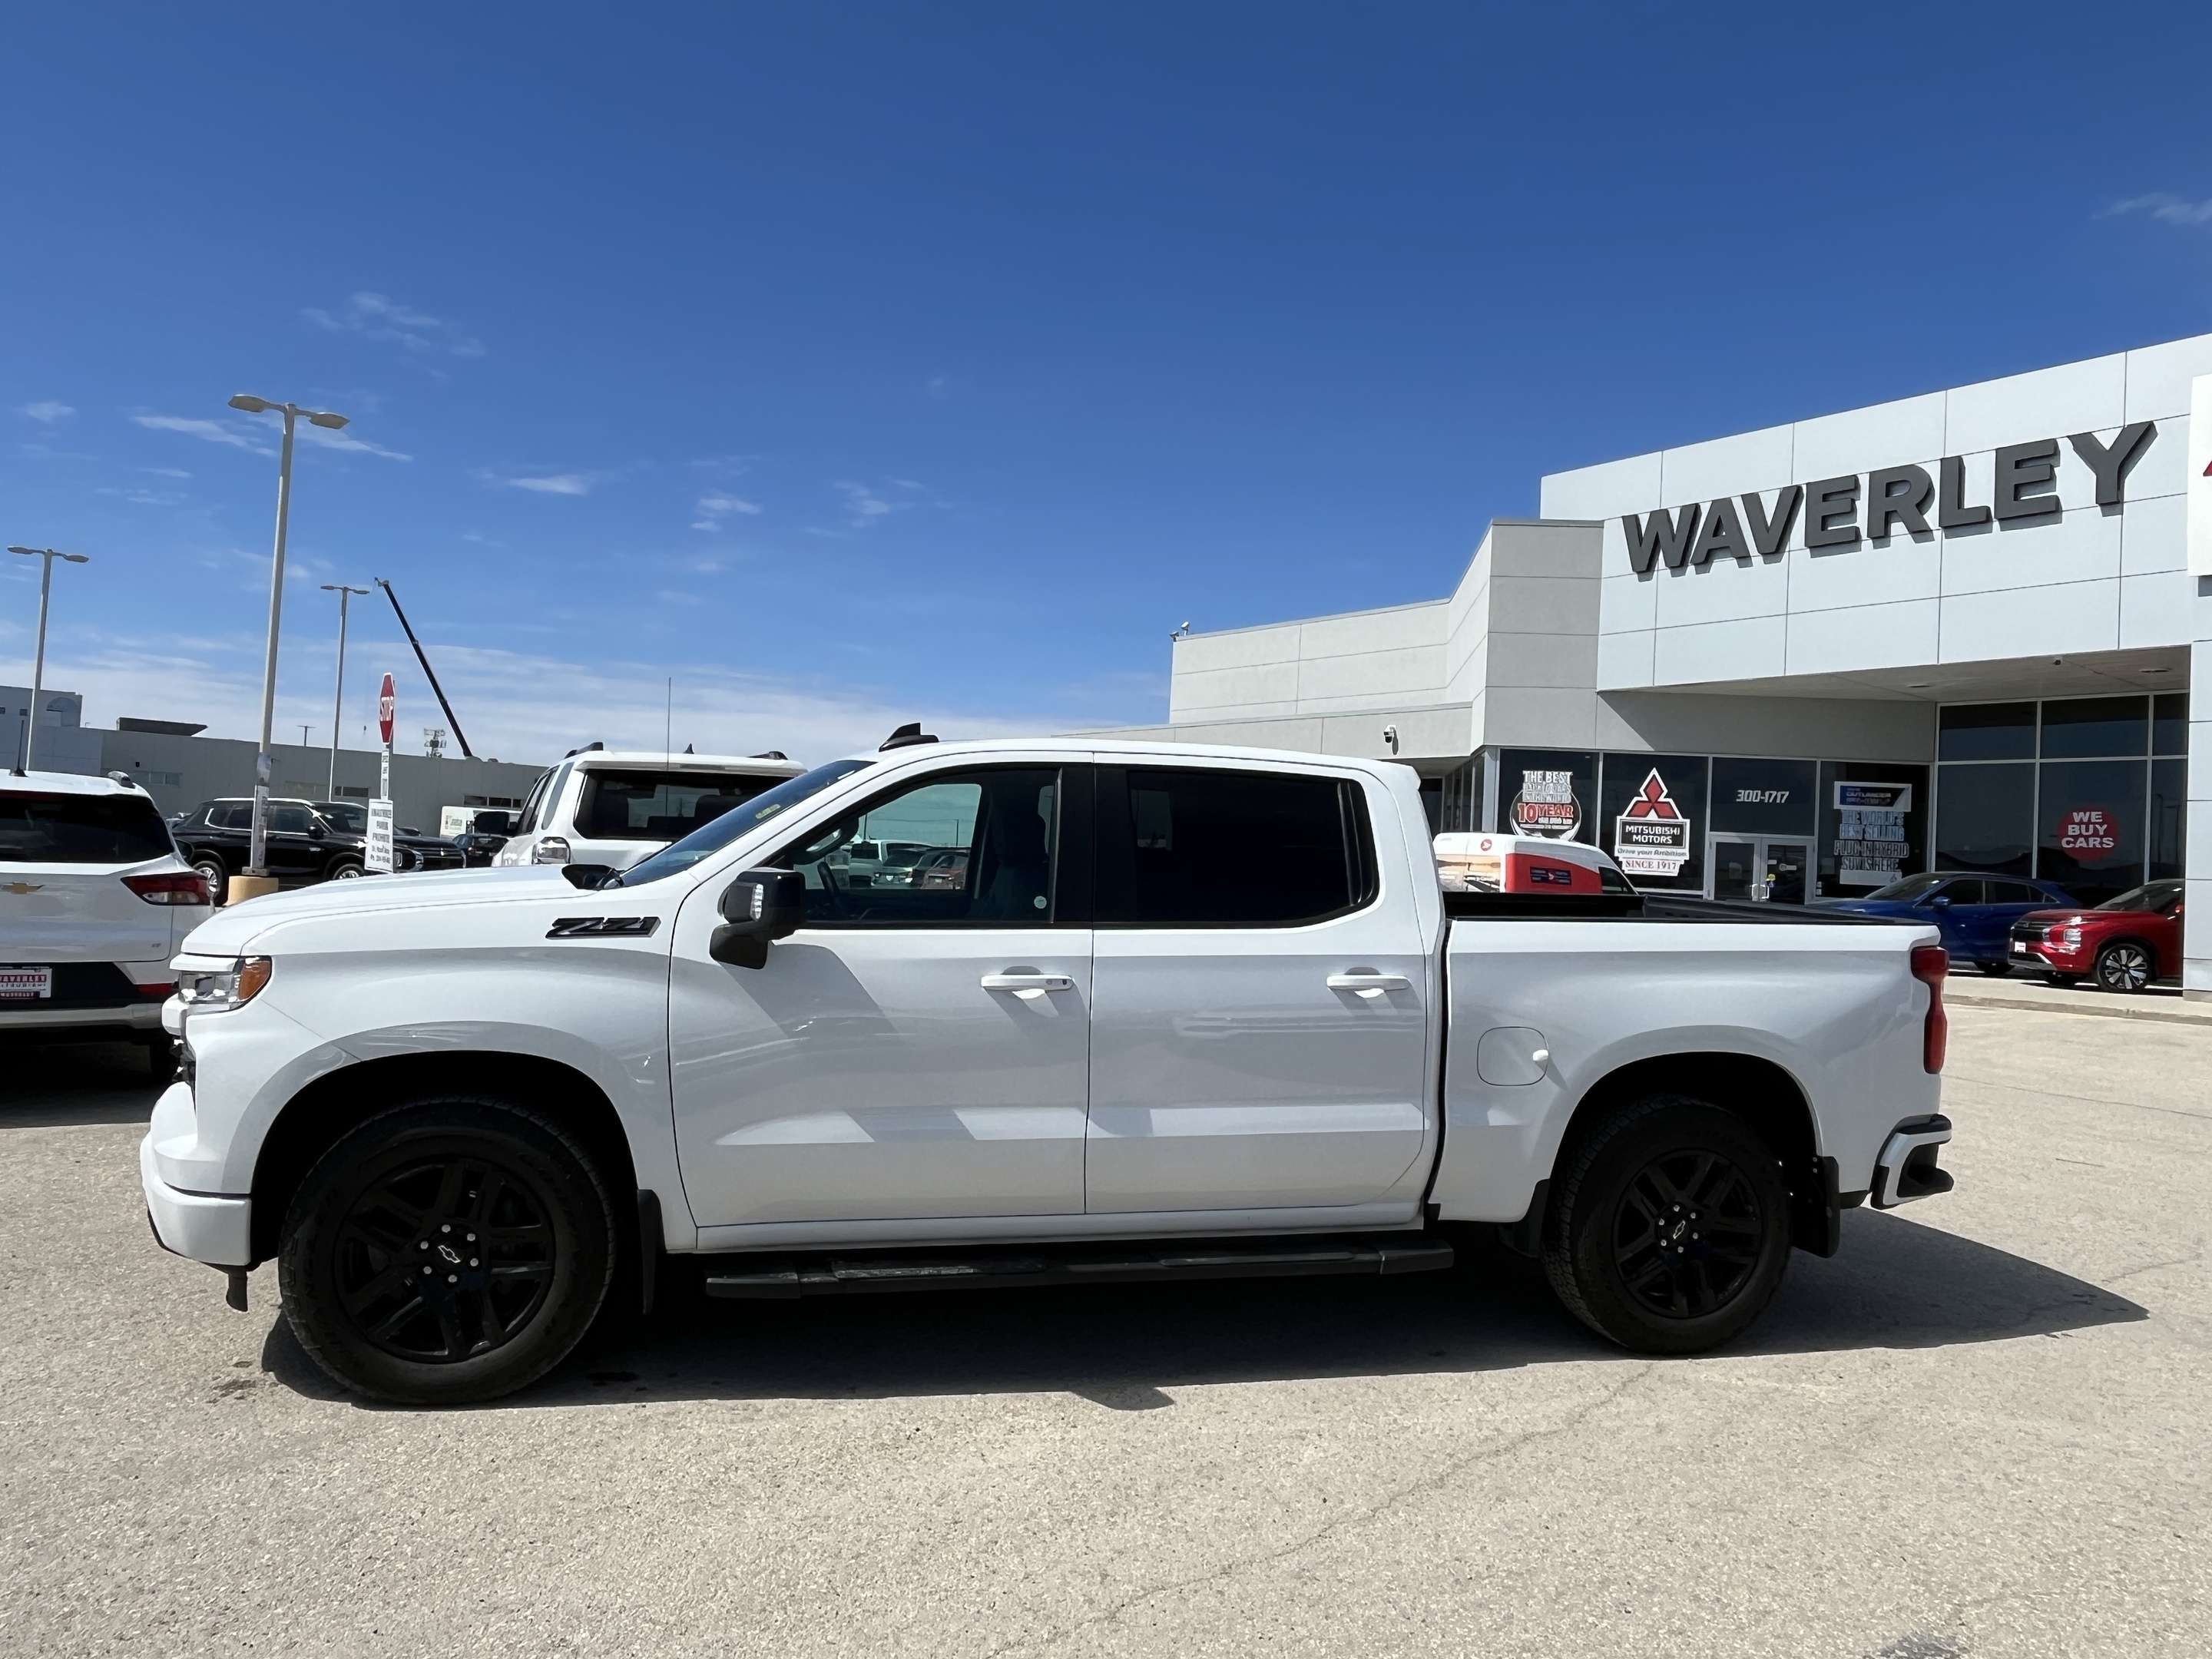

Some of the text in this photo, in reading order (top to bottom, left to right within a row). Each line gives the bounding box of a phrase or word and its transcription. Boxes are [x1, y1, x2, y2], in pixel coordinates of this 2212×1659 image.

[1621, 421, 2157, 574] WAVERLEY
[1522, 770, 1573, 783] THE BEST
[1736, 790, 1790, 803] 300-1717
[1518, 803, 1538, 823] 10
[1538, 803, 1574, 818] YEAR
[2072, 811, 2103, 823] WE
[1625, 825, 1681, 835] MITSUBISHI
[2068, 824, 2108, 836] BUY
[1633, 835, 1672, 844] MOTORS
[2061, 837, 2114, 848] CARS
[1873, 841, 1909, 858] HYBRID
[1625, 859, 1677, 870] SINCE 1917
[1873, 858, 1899, 872] HERE
